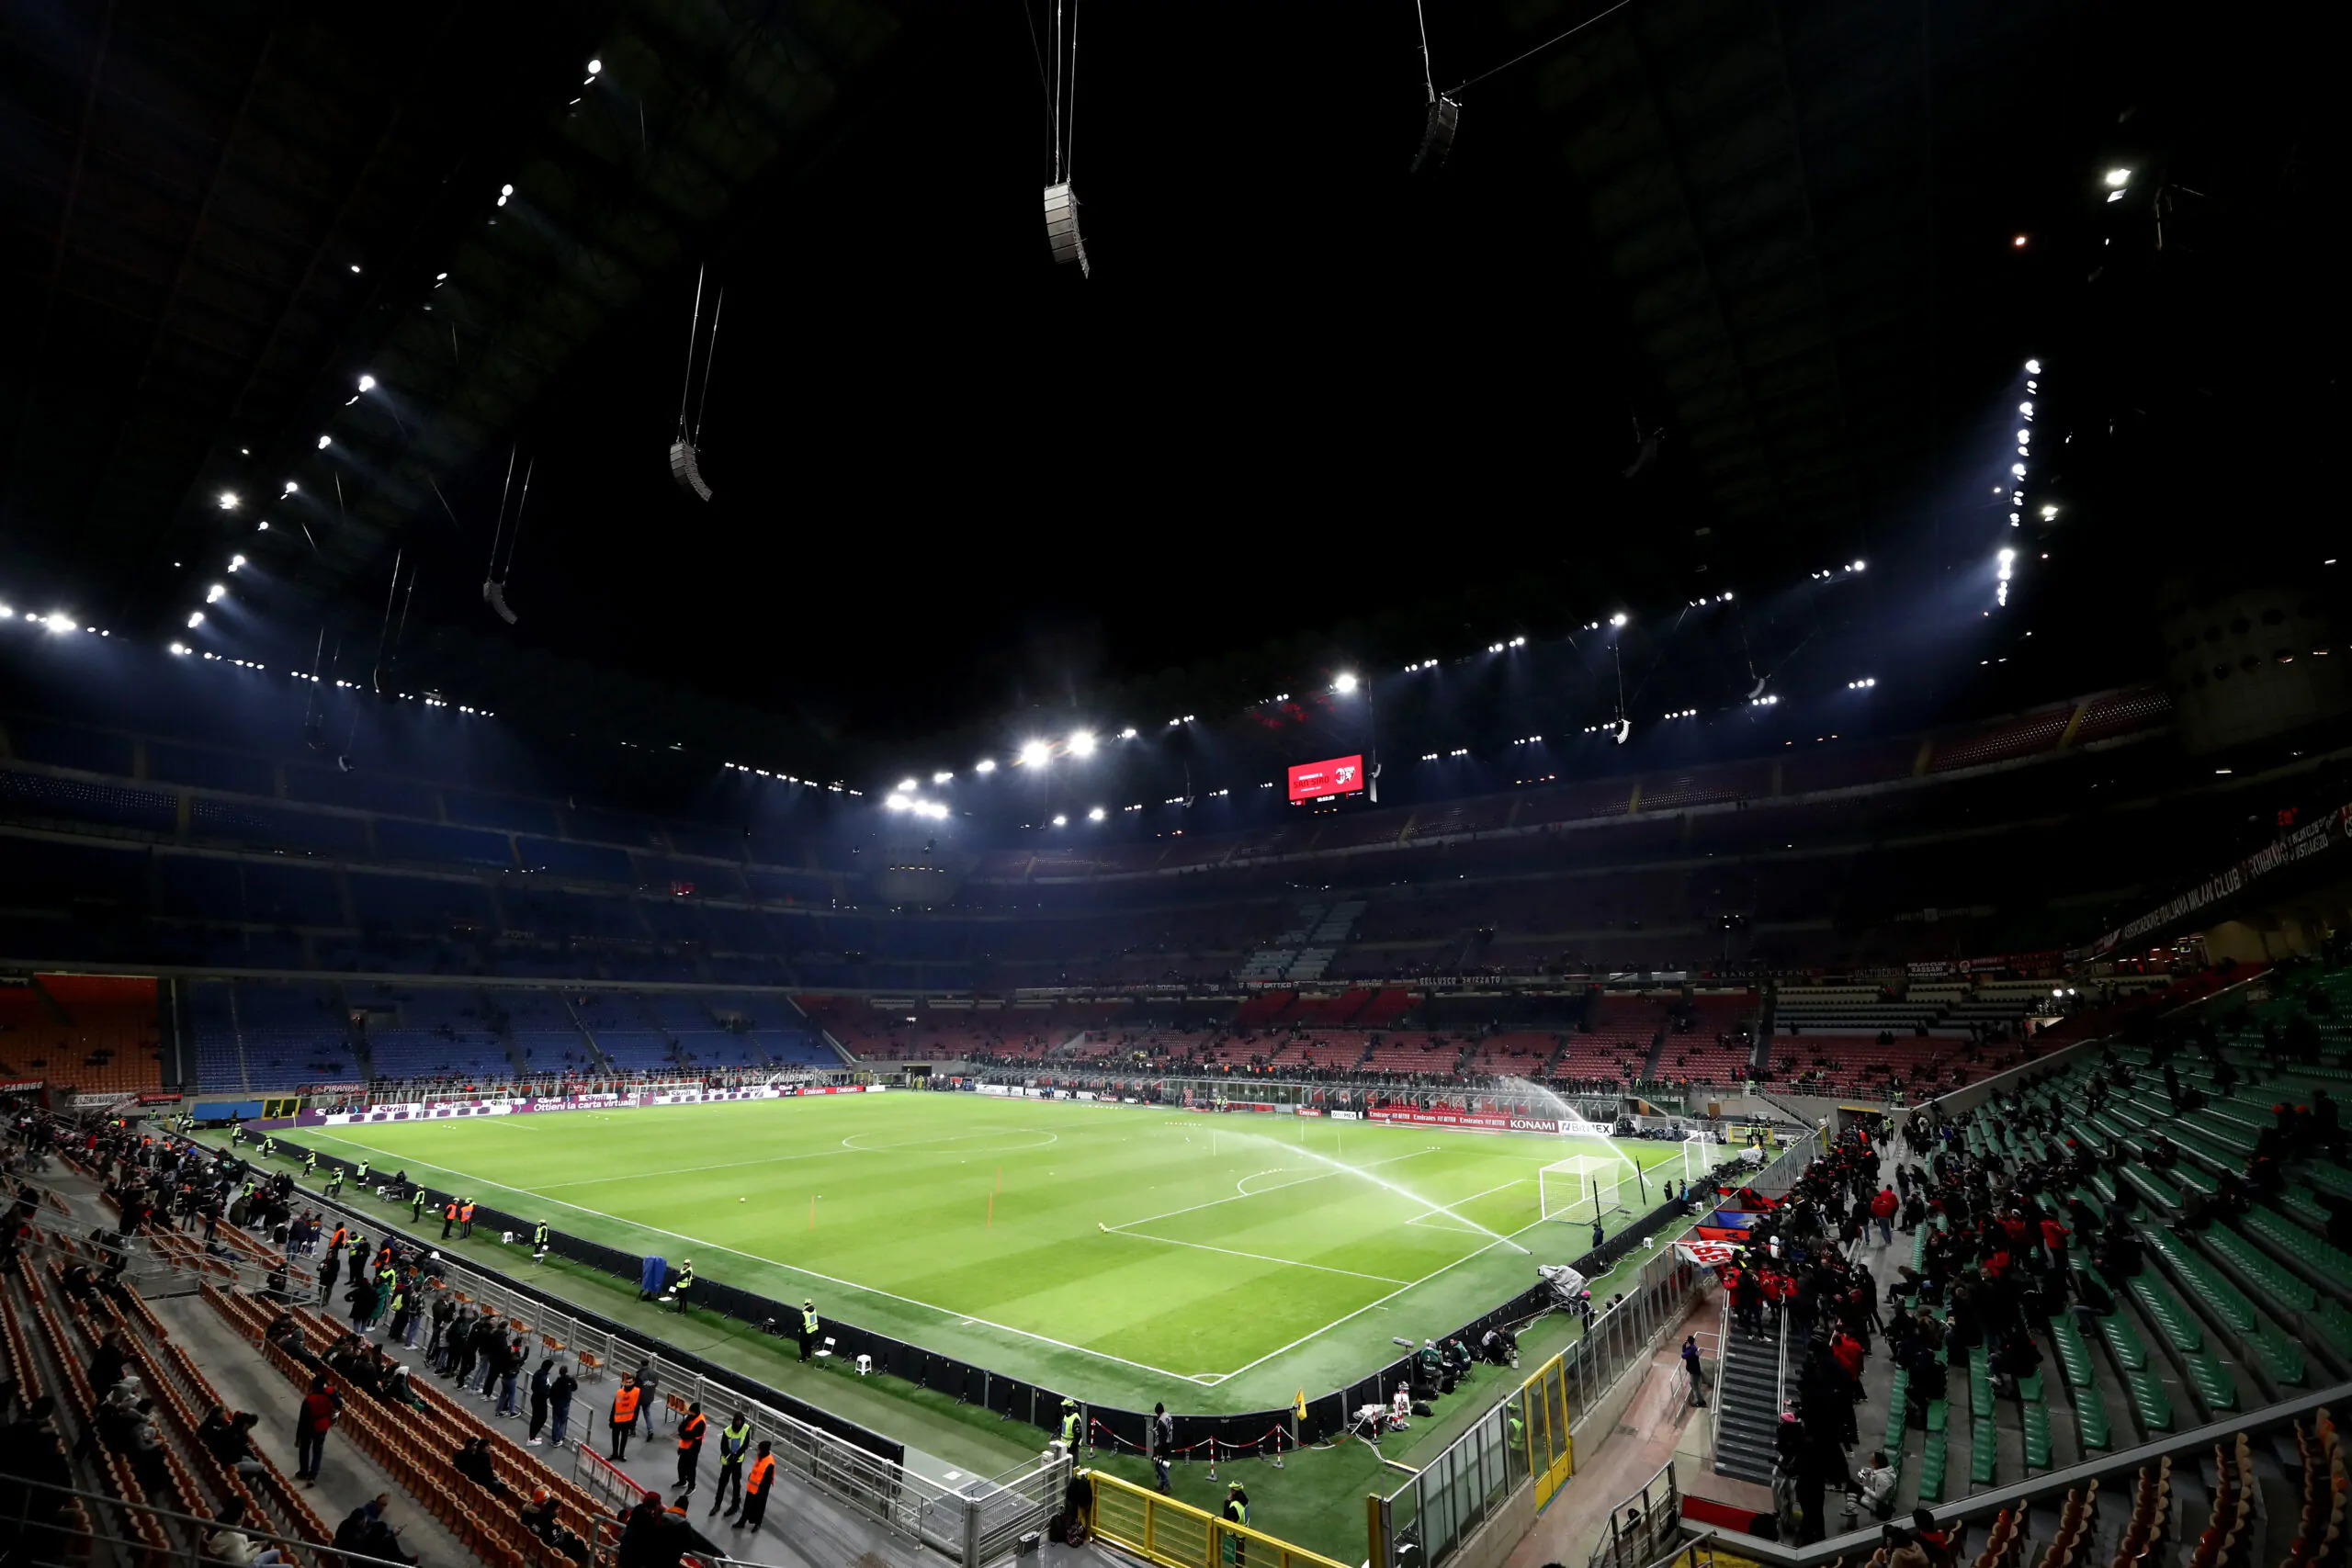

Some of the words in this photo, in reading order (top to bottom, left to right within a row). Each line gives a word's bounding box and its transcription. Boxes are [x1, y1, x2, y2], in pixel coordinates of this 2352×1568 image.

[2188, 882, 2214, 911] MILAN
[2214, 868, 2242, 899] CLUB
[1712, 970, 1755, 978] ABANO
[1768, 969, 1813, 977] TERME
[1419, 976, 1456, 986] BELLUSCO
[323, 1085, 359, 1093] PIRANHA
[379, 1104, 408, 1113] Skrill
[534, 1102, 565, 1111] Ottieni
[568, 1101, 575, 1110] la
[578, 1100, 602, 1109] carta
[604, 1099, 637, 1107] virtuale
[1413, 1113, 1435, 1122] Emirates
[1460, 1117, 1484, 1125] Emirates
[1510, 1119, 1555, 1132] KONAMI
